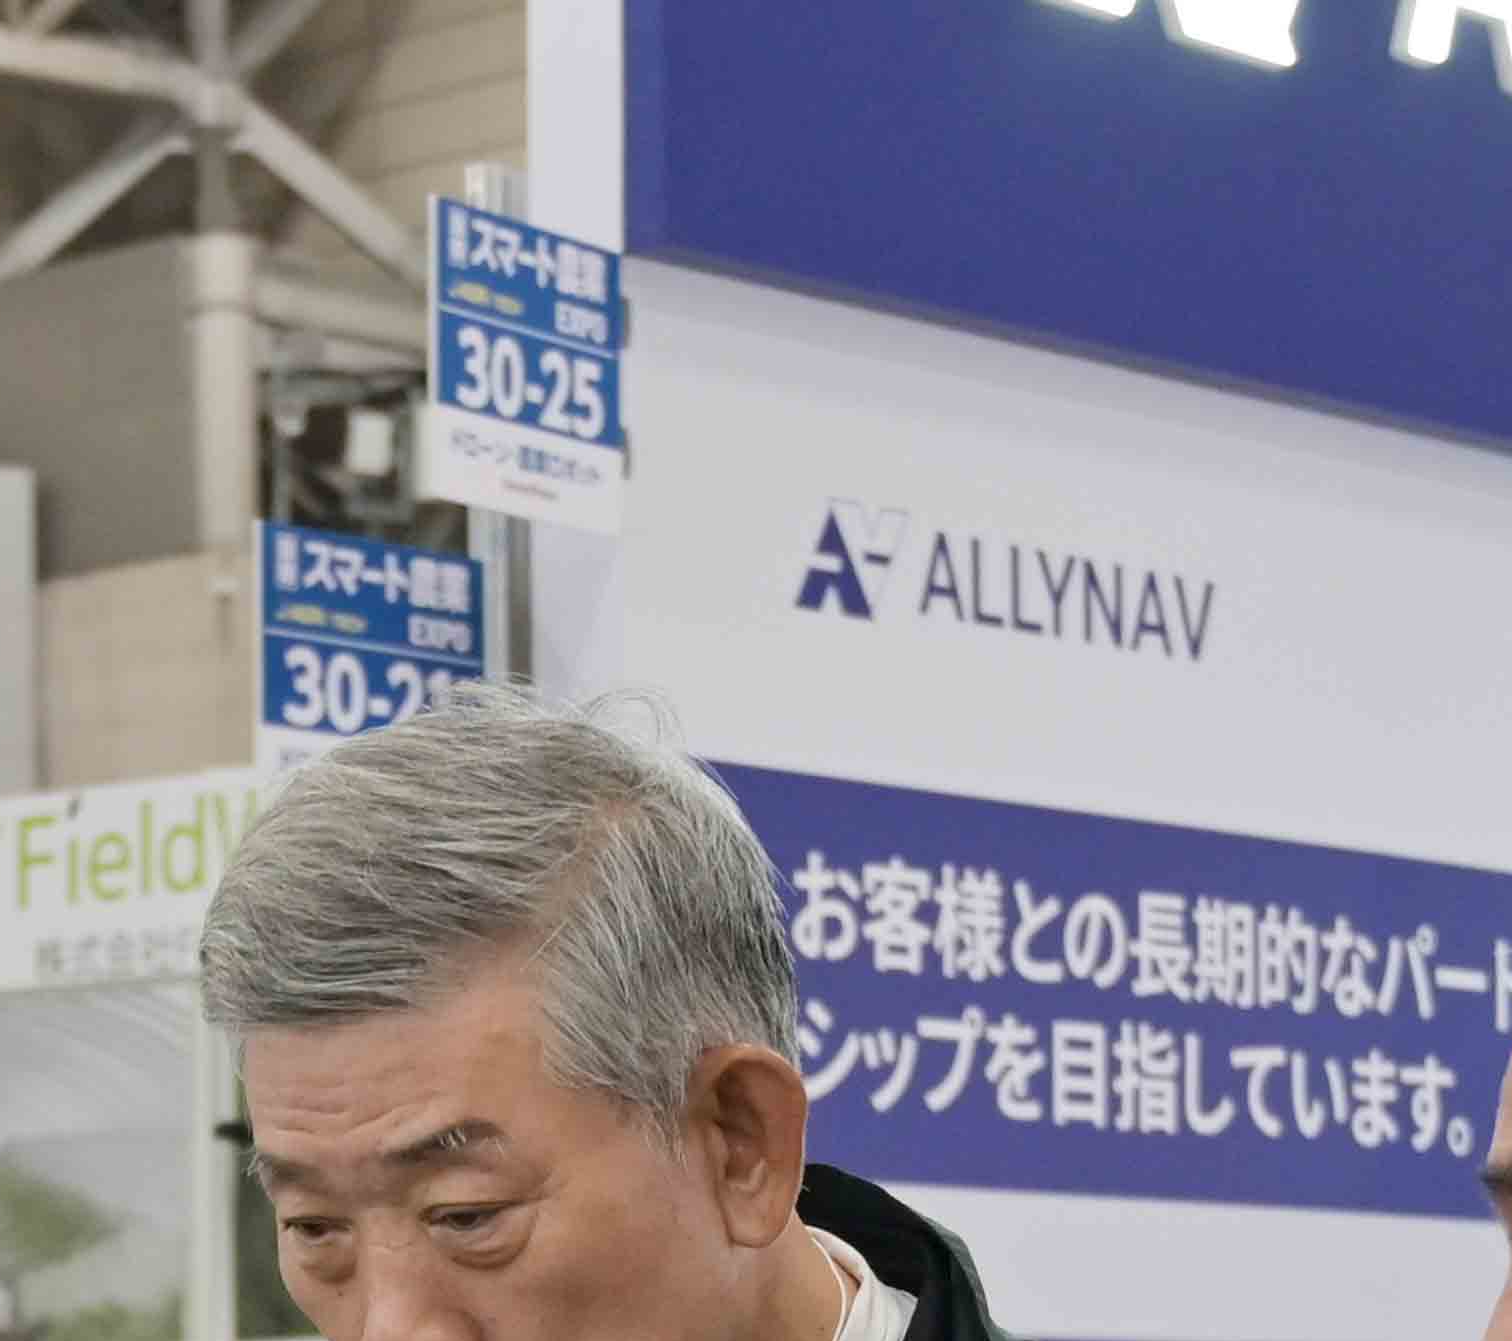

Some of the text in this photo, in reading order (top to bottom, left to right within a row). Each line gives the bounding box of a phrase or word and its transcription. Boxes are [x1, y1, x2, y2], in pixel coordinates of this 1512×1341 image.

[456, 325, 605, 439] 30-25
[918, 529, 1214, 662] ALLYNAV
[797, 999, 1474, 1157] シップを目指しています。
